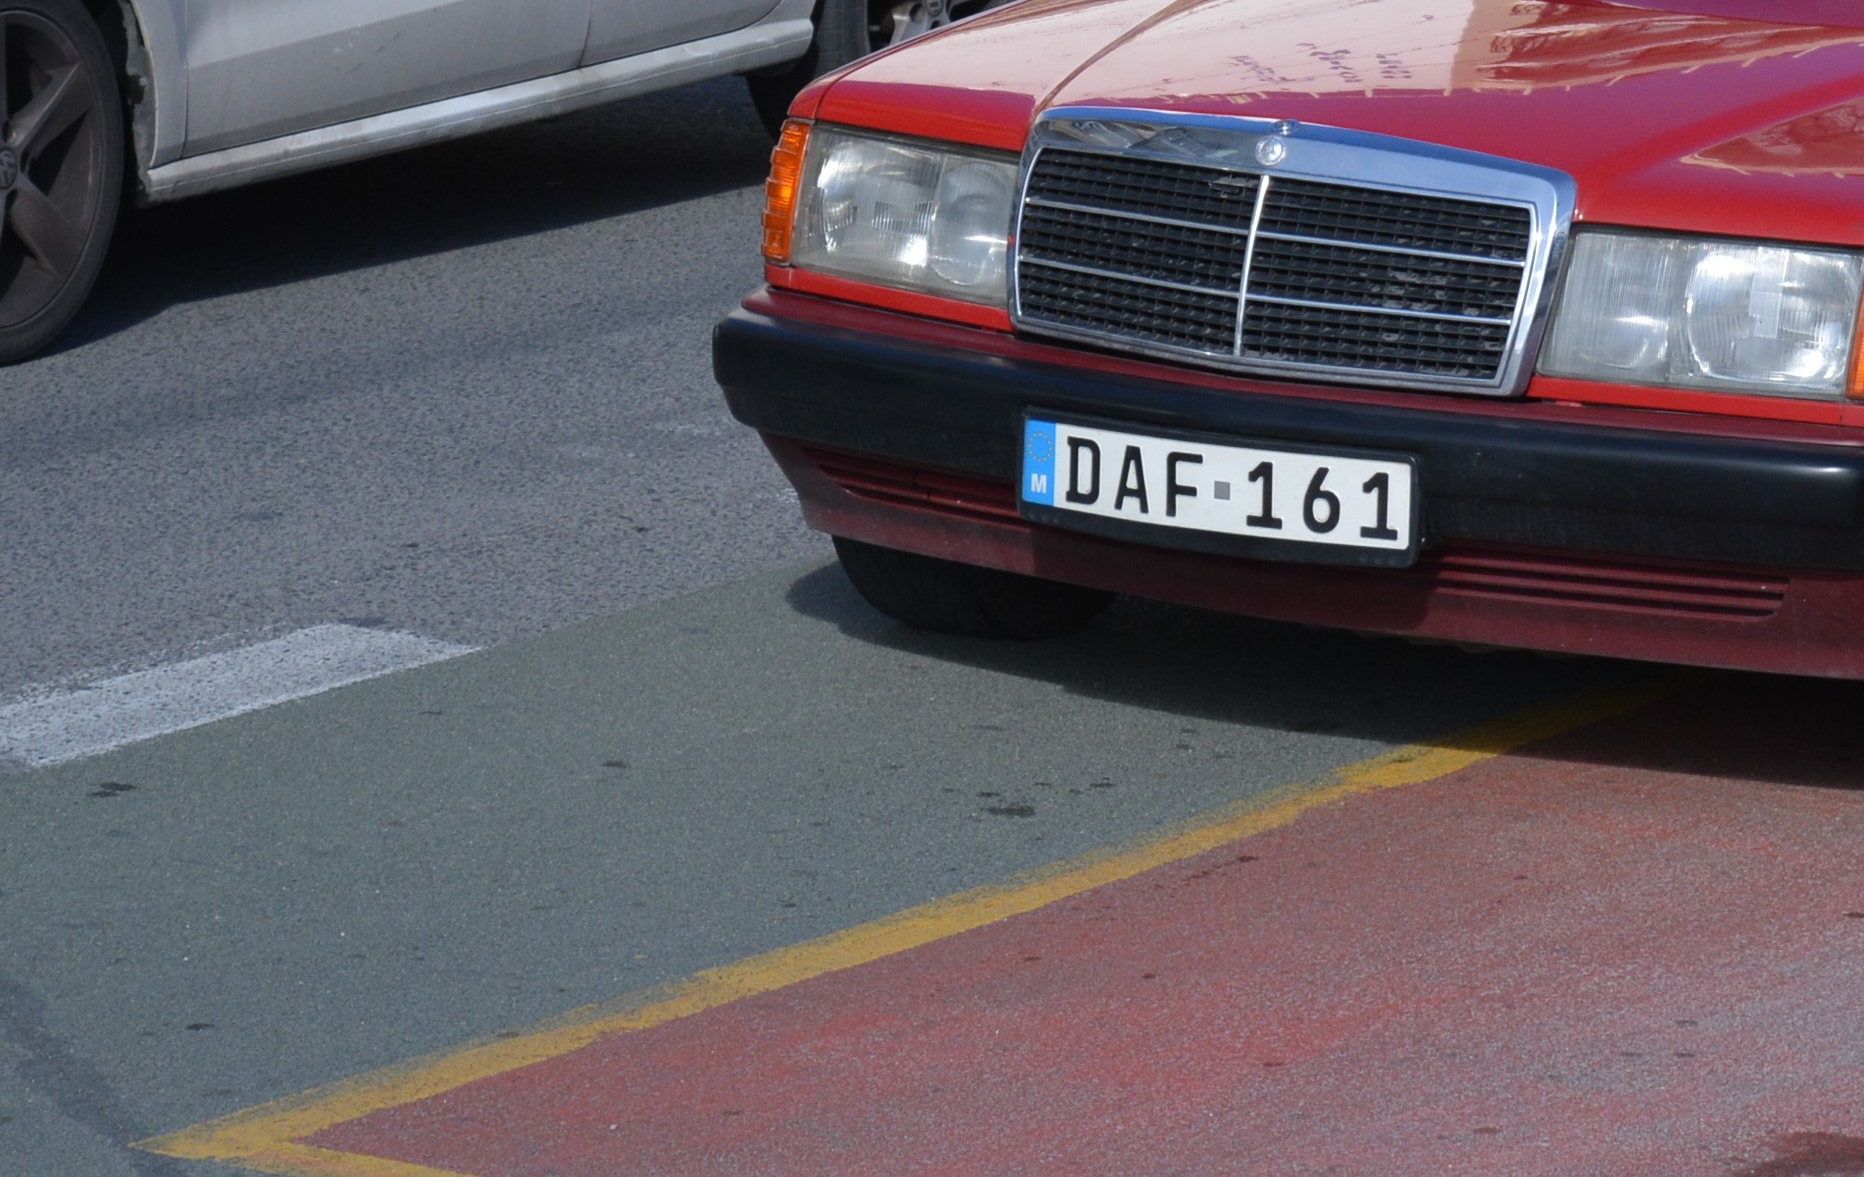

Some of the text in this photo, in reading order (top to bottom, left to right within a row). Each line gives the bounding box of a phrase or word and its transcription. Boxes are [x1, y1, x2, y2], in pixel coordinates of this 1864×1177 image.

[1030, 473, 1047, 494] M
[1065, 435, 1399, 541] DAF 161
